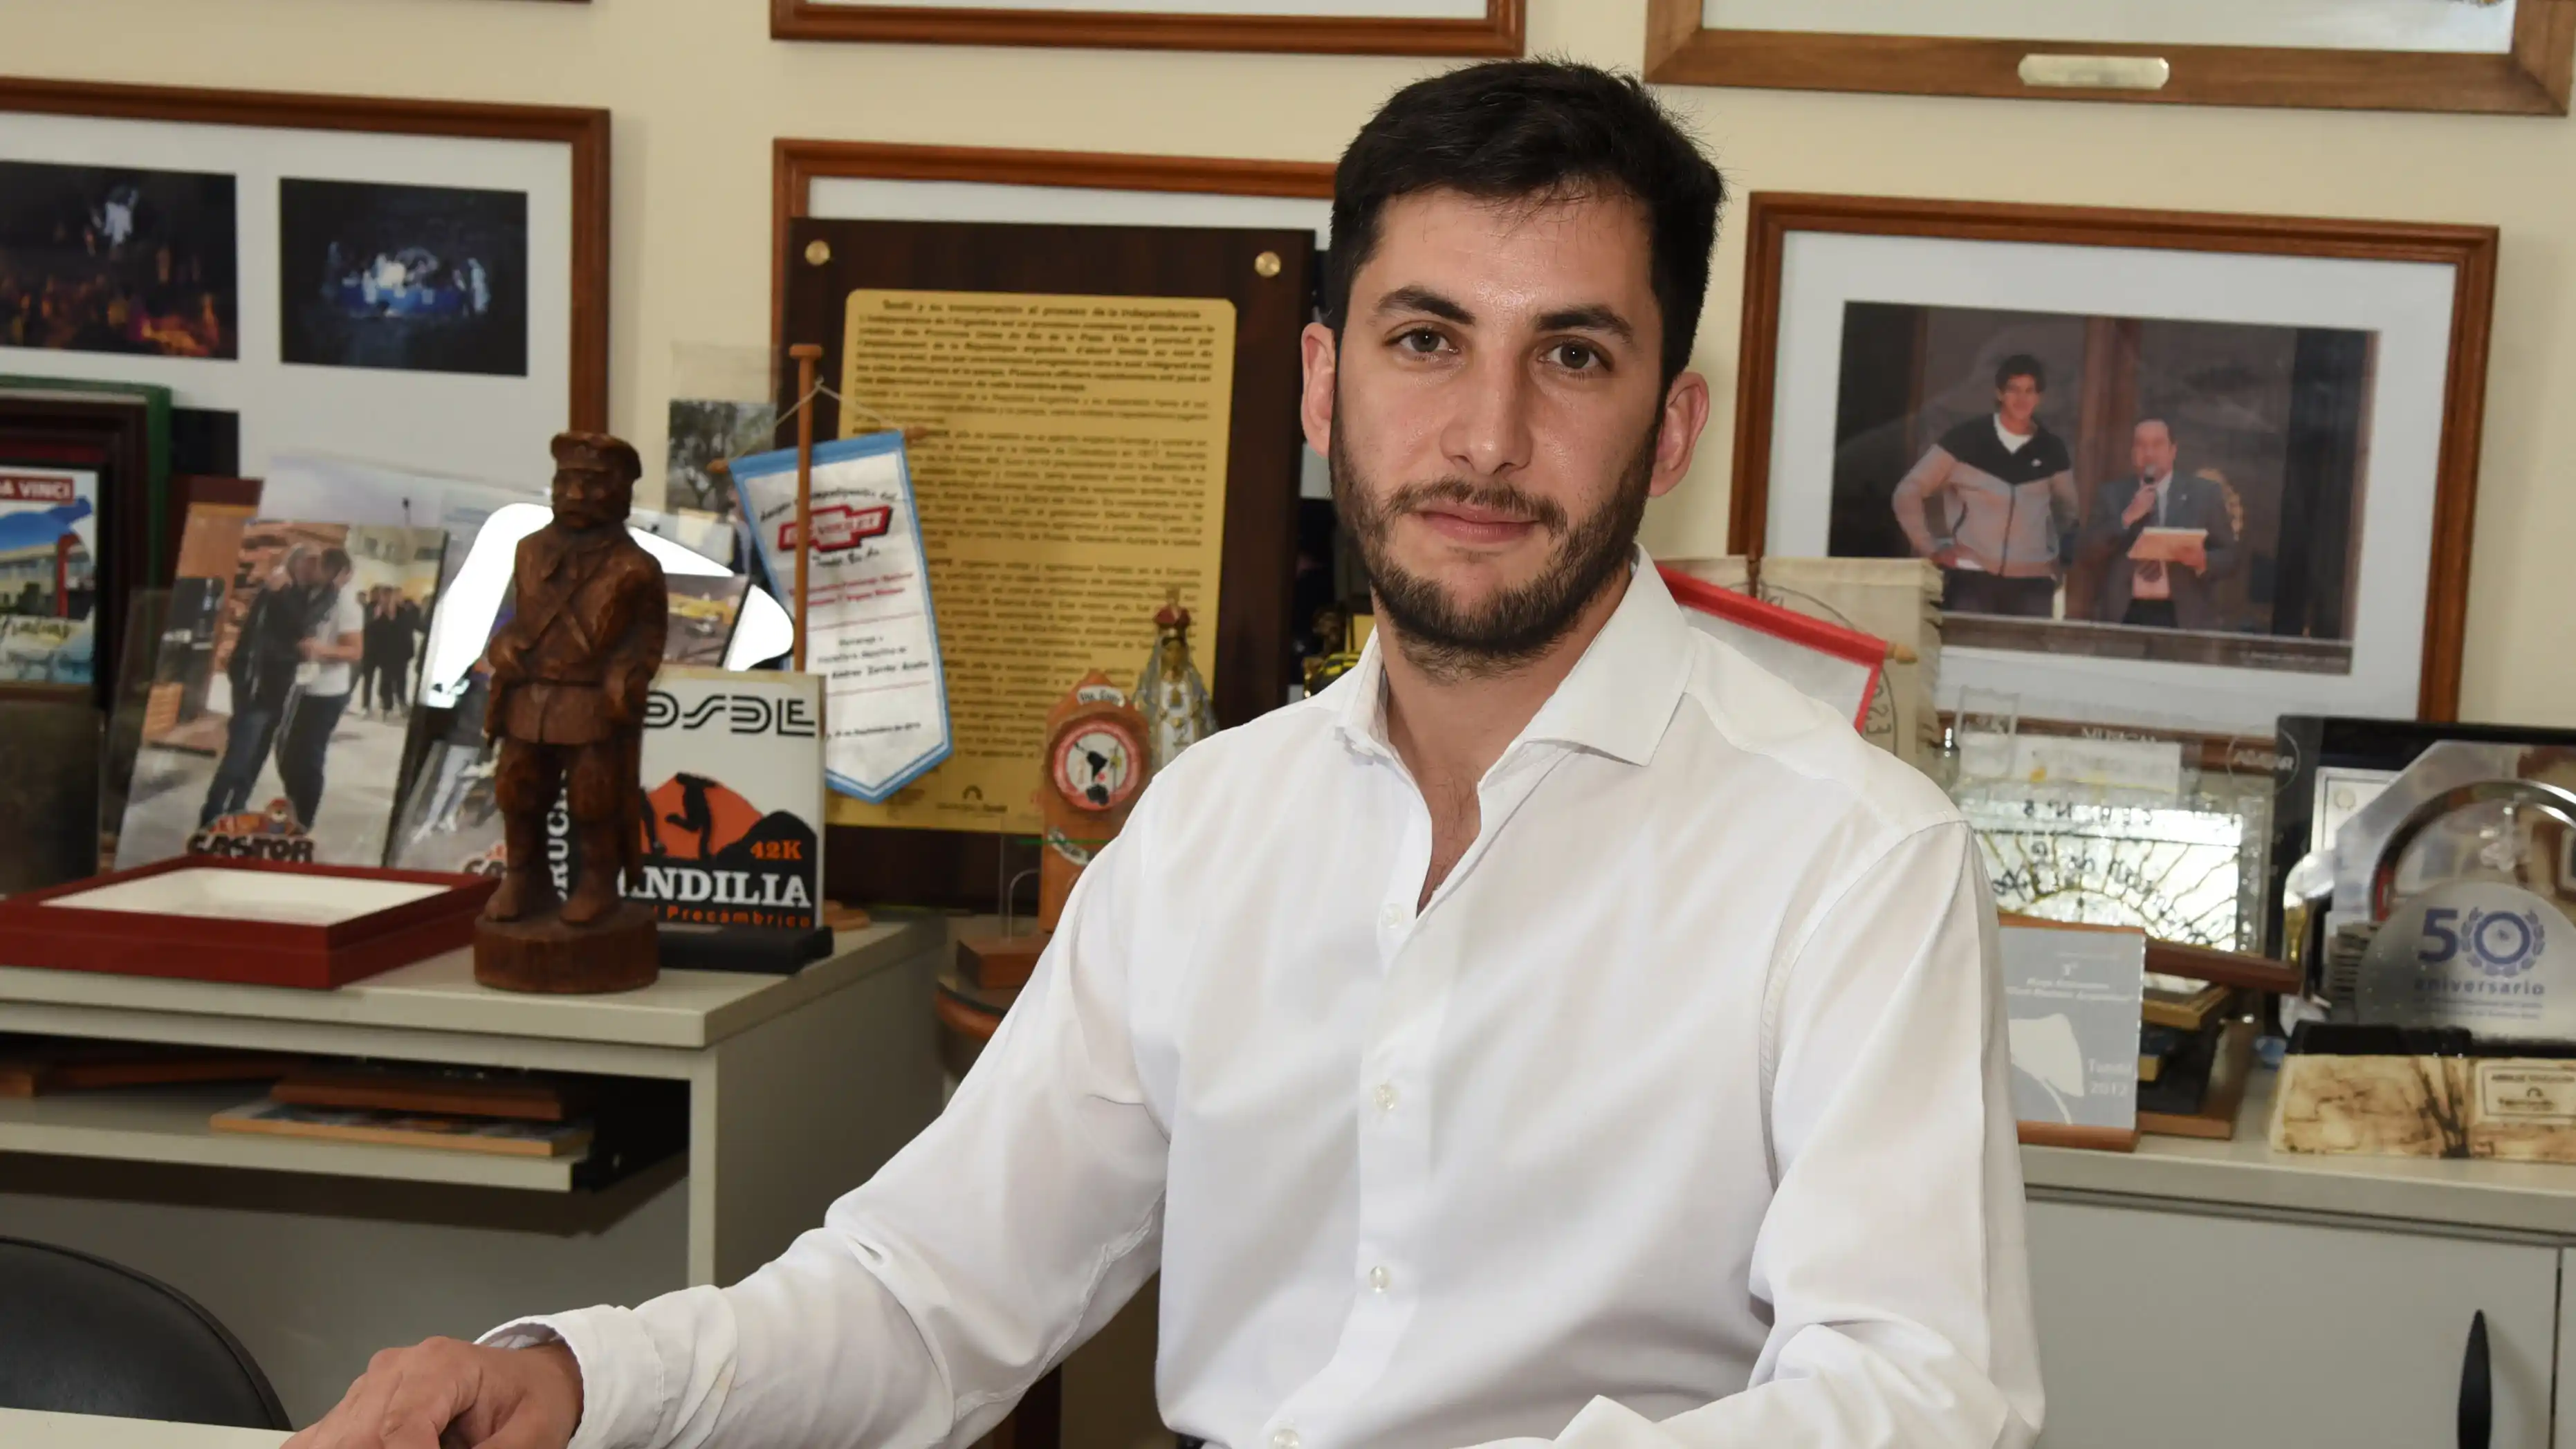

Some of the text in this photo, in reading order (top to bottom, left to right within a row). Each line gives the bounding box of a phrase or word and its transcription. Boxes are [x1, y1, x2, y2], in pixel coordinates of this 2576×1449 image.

[19, 479, 72, 499] VINCI
[643, 691, 816, 737] OSDE
[186, 831, 315, 864] CASTOR
[750, 839, 803, 861] 42K
[2418, 907, 2530, 966] 50
